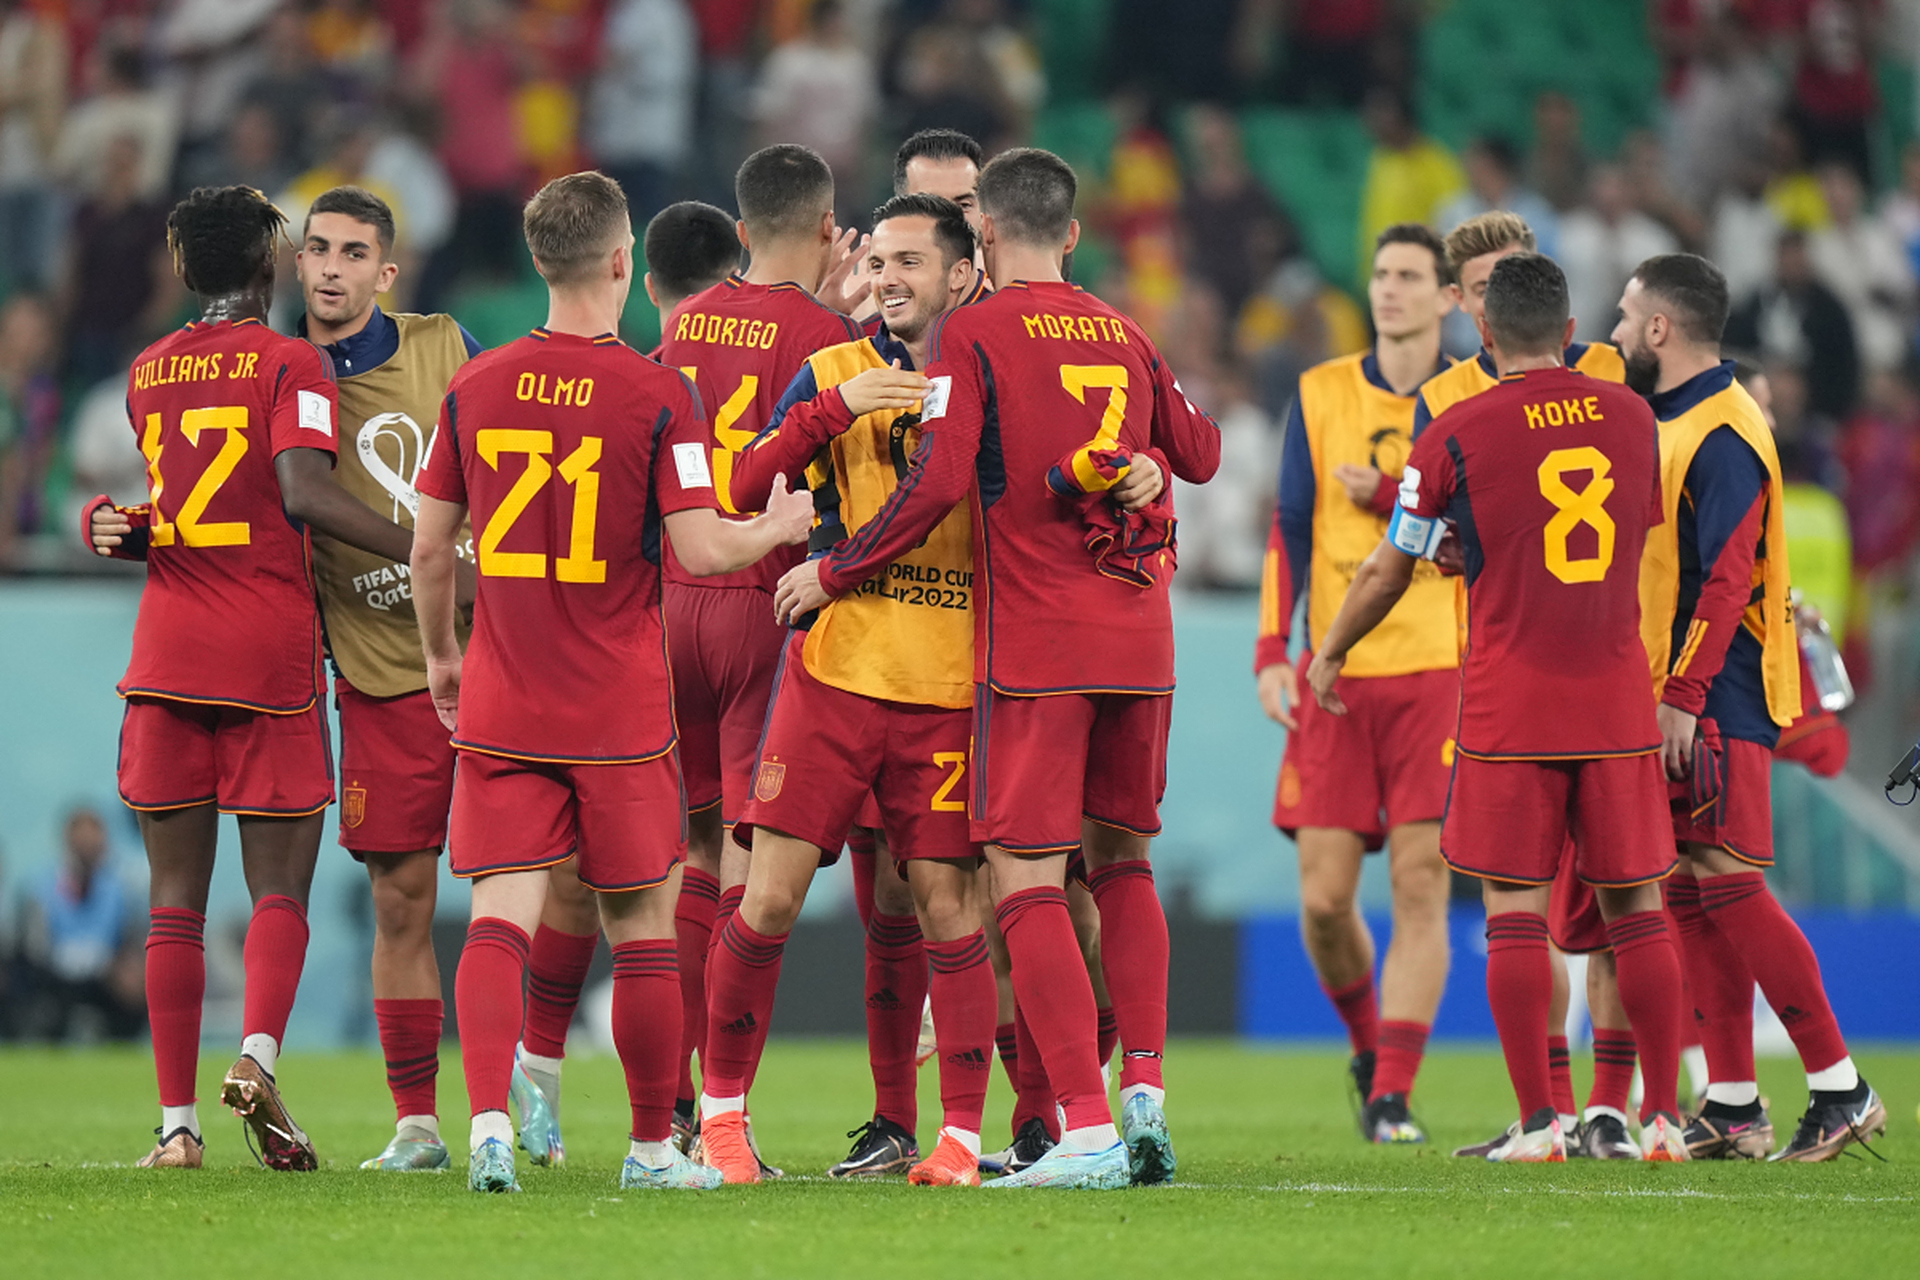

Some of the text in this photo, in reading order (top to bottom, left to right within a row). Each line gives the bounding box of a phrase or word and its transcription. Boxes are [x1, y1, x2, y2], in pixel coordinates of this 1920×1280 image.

[675, 313, 778, 350] RODRIGO
[1021, 313, 1130, 345] MORATA
[134, 352, 259, 392] WILLIAMS JR.
[516, 371, 595, 408] OLMO
[1059, 364, 1129, 442] 7
[1523, 396, 1604, 430] KOKE
[680, 366, 760, 518] 6
[141, 405, 251, 548] 12
[475, 428, 607, 584] 21
[1537, 446, 1616, 584] 8
[352, 567, 396, 593] FIFA
[883, 562, 941, 583] ORLD
